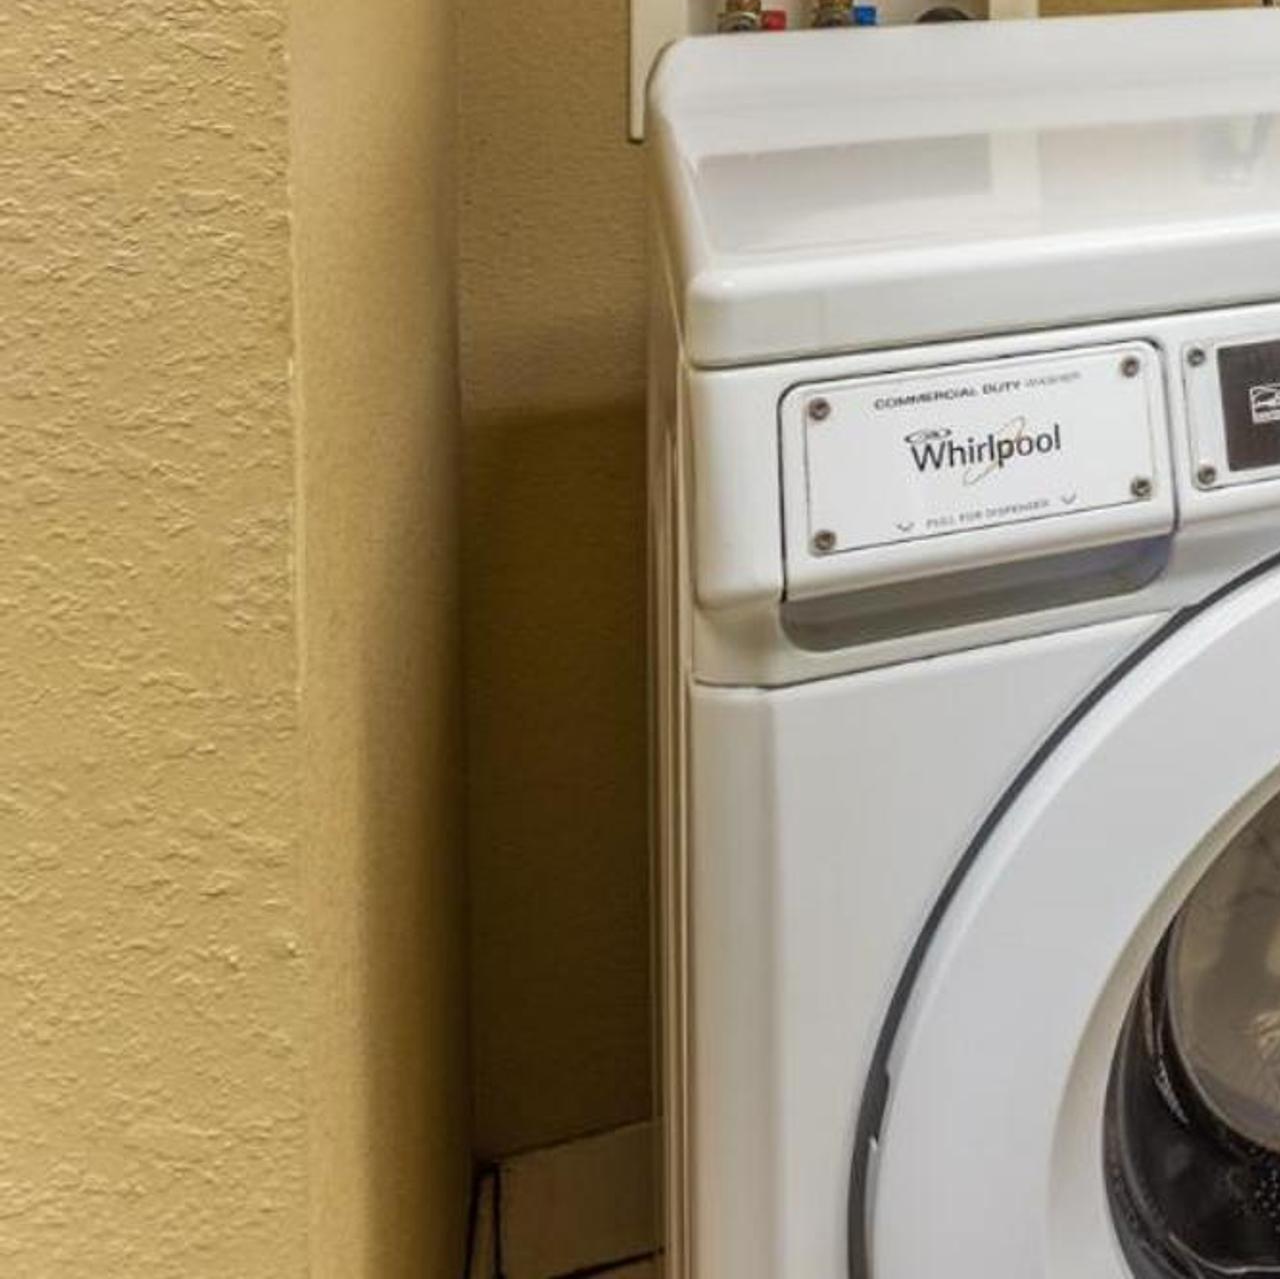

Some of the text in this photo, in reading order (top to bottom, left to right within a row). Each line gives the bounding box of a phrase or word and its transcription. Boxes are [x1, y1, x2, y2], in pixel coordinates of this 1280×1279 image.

[873, 384, 978, 410] COMMERCIAL
[982, 379, 1022, 396] DUTY
[911, 423, 1062, 472] Whirlpool
